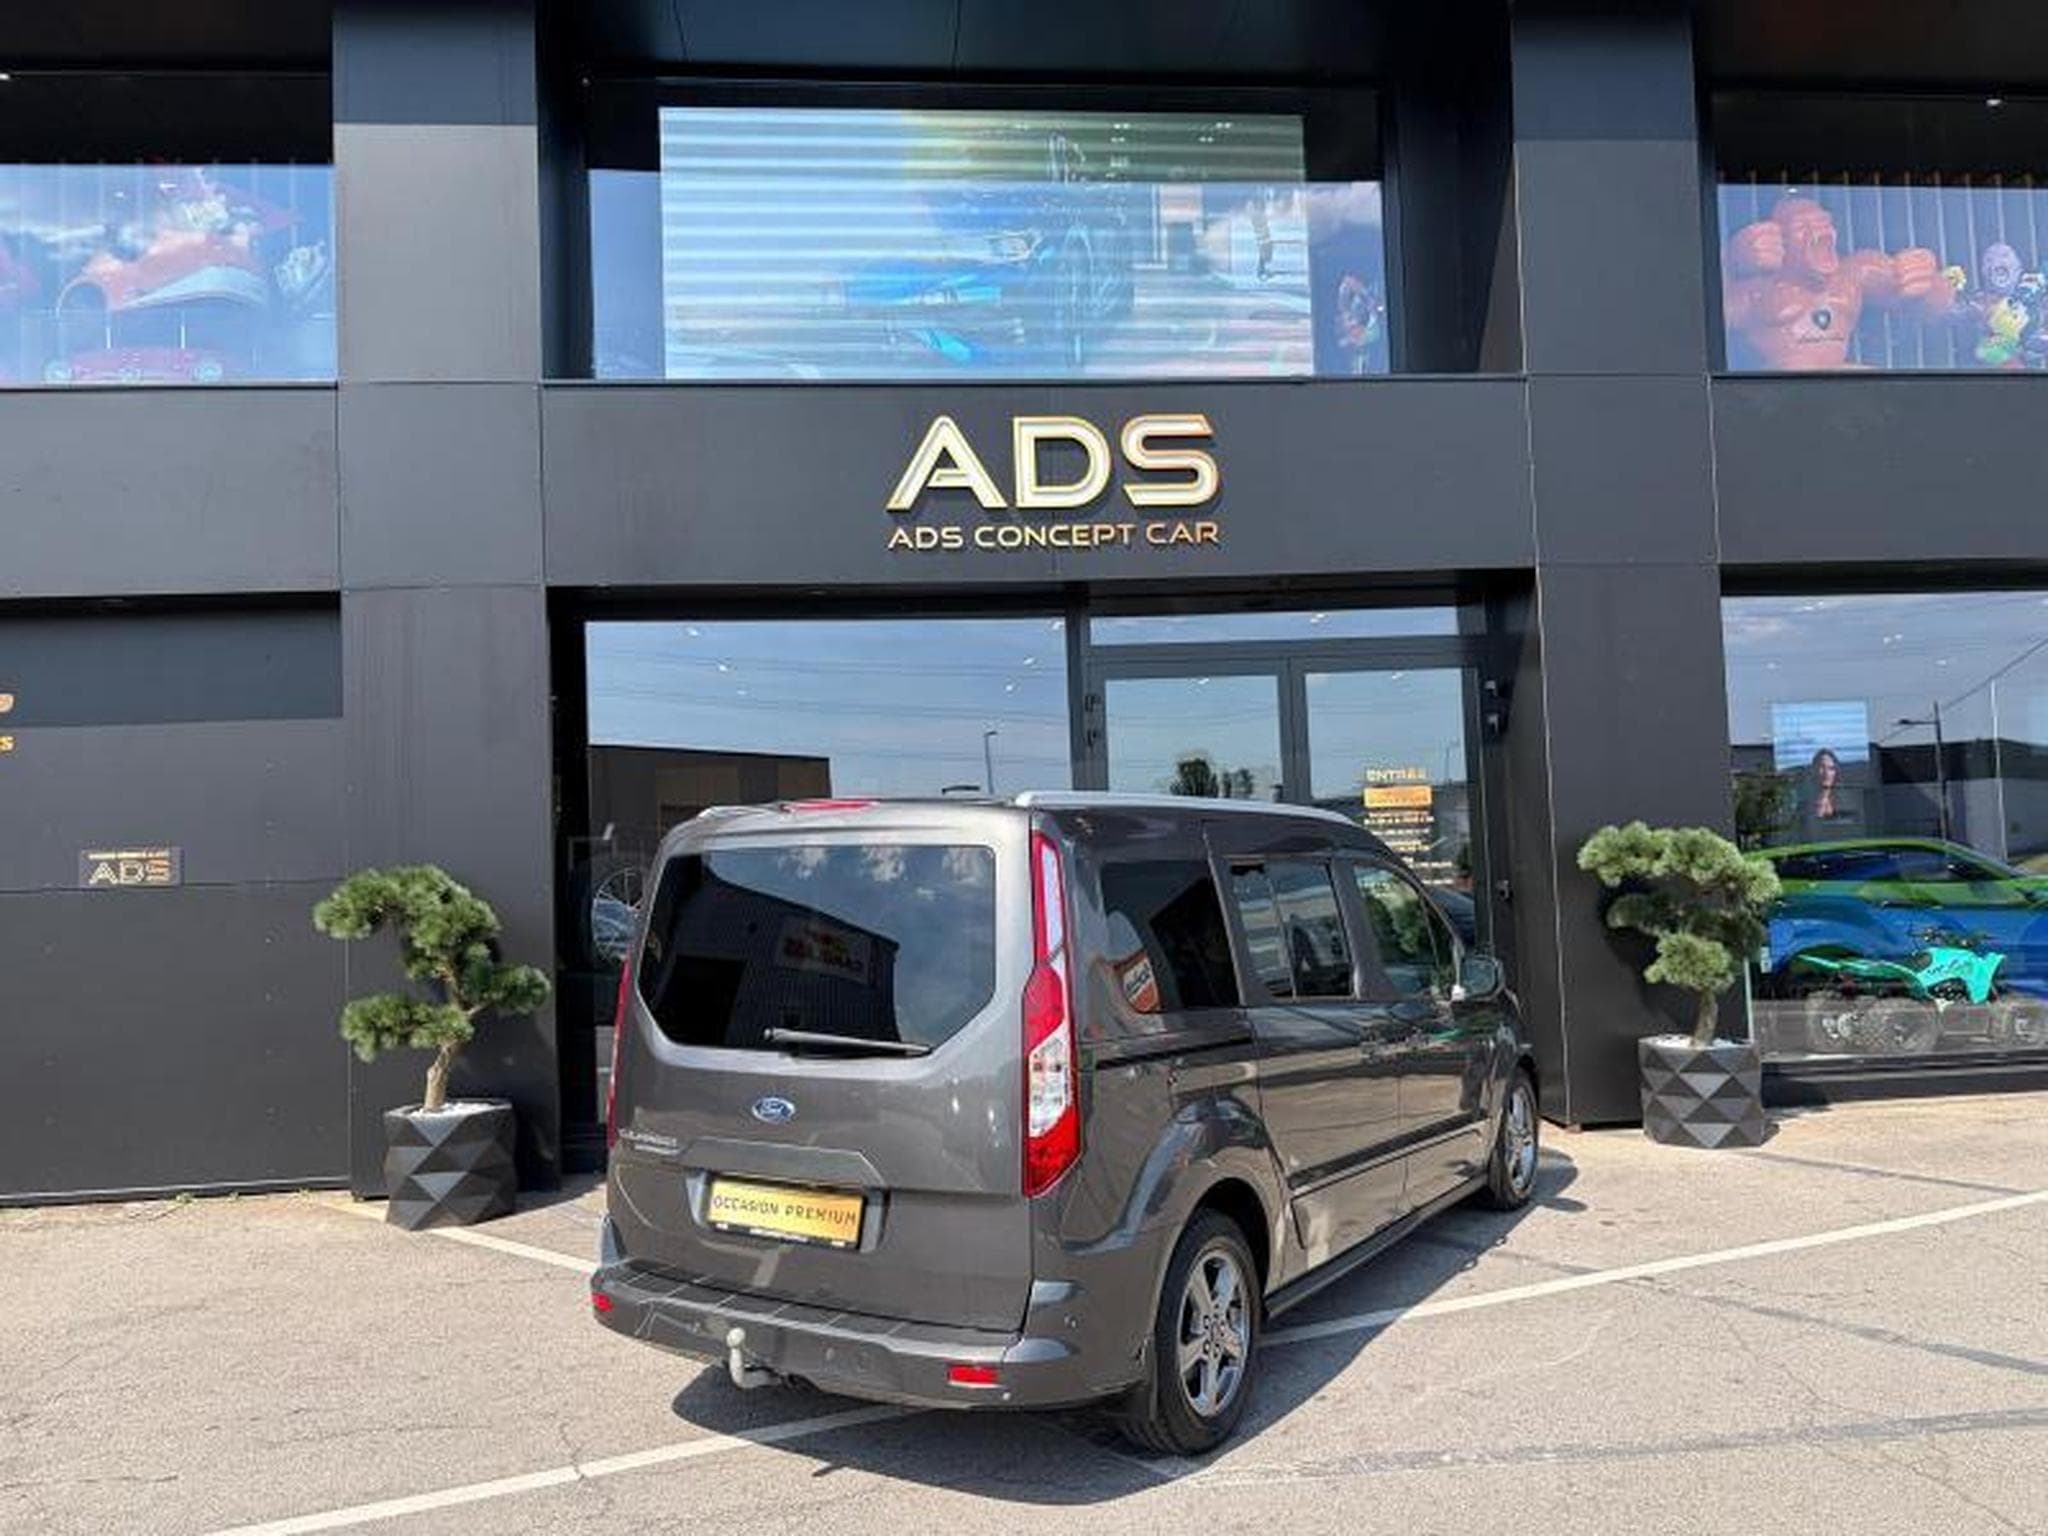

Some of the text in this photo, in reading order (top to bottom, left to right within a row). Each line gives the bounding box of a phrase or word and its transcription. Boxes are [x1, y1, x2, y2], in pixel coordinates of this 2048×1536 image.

[886, 413, 1219, 511] ADS
[888, 522, 1220, 549] ADS CONCEPT CAR
[88, 861, 170, 885] ADS
[713, 1195, 857, 1225] OCCASION PREMIUM
